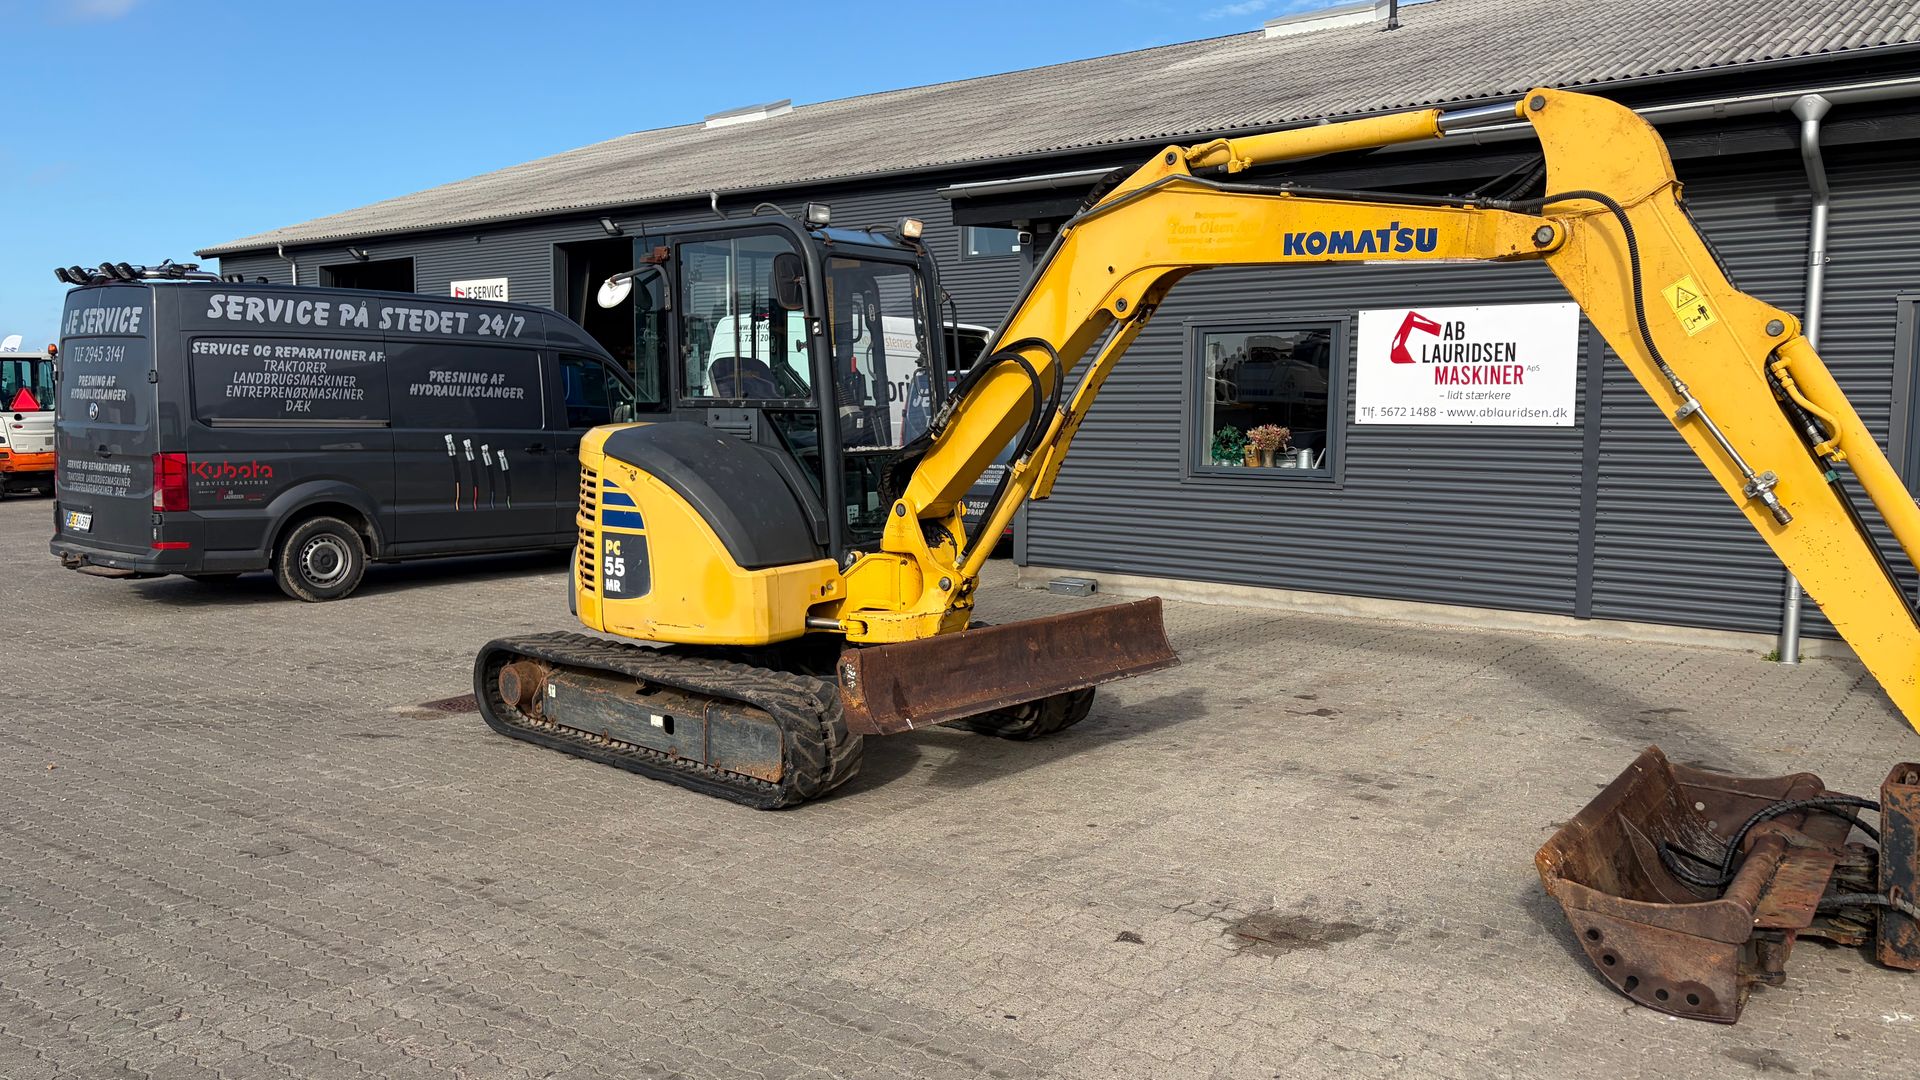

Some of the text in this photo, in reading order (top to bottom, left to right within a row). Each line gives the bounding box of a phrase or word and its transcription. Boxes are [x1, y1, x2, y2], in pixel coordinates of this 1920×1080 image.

[1283, 221, 1438, 256] KOMATSU
[473, 284, 504, 299] SERVICE
[65, 306, 143, 335] JE SERVICE
[207, 294, 526, 339] SERVICE PÅ STEDET 24/7
[1443, 320, 1466, 341] AB
[85, 345, 104, 364] 2945
[105, 345, 126, 363] 3141
[192, 341, 386, 362] SERVICE OG REPARATIONER AF:
[1422, 342, 1516, 363] LAURIDSEN
[263, 359, 327, 374] TRAKTORER
[1434, 364, 1541, 385] MASKINER ApS
[78, 374, 117, 387] PRESNING AF
[233, 371, 356, 388] LANDBRUGSMASKINER
[429, 370, 506, 385] PRESNING AF
[70, 387, 127, 401] HYDRAULIKSLANGER
[226, 384, 364, 400] ENTREPRENØRMASKINER
[409, 383, 524, 399] HYDRAULIKSLANGER
[1447, 390, 1464, 400] lidt
[1465, 390, 1512, 400] stærkere
[285, 399, 312, 412] DÆK
[1361, 406, 1377, 419] Tlf.
[1380, 407, 1407, 417] 5672
[1409, 407, 1437, 417] 1488
[1446, 407, 1568, 418] www.ablauridsen.dk
[191, 460, 273, 480] Kubota
[605, 538, 621, 556] PC
[604, 555, 626, 577] 55
[605, 578, 622, 593] MR
